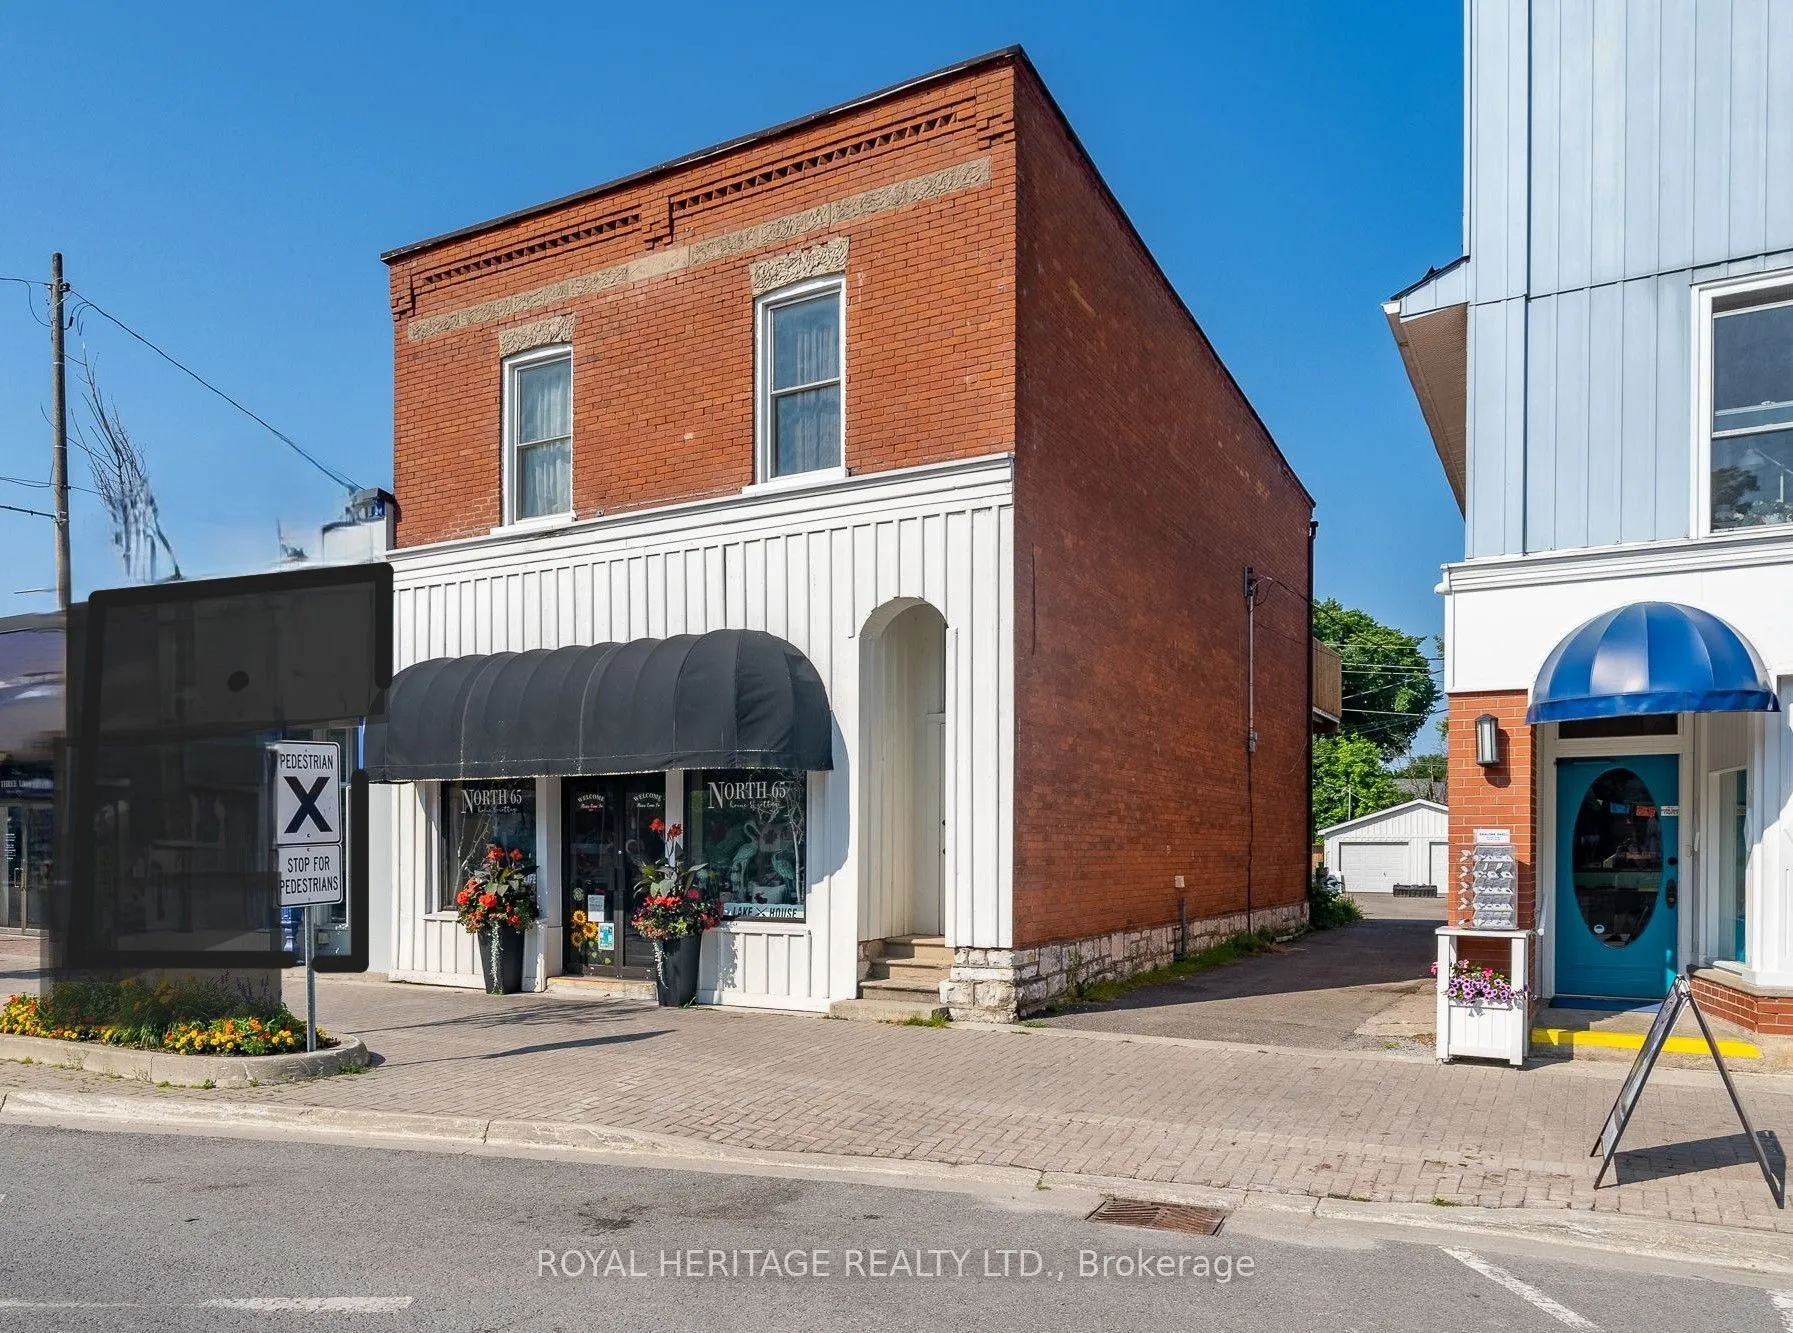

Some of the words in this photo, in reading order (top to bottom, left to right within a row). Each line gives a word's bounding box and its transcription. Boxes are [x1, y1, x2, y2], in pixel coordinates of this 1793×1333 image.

[280, 754, 334, 770] PEDESTRIAN
[460, 789, 508, 814] NORTH
[510, 789, 522, 805] 65
[577, 793, 605, 803] WELCOME
[633, 792, 662, 802] WELCOME
[707, 781, 768, 809] NORTH
[771, 781, 786, 799] 65
[283, 776, 334, 834] X
[287, 857, 310, 873] STOP
[313, 855, 331, 872] FOR
[280, 875, 339, 895] PEDESTRIANS
[733, 906, 753, 917] LAKE
[769, 907, 798, 918] HOUSE
